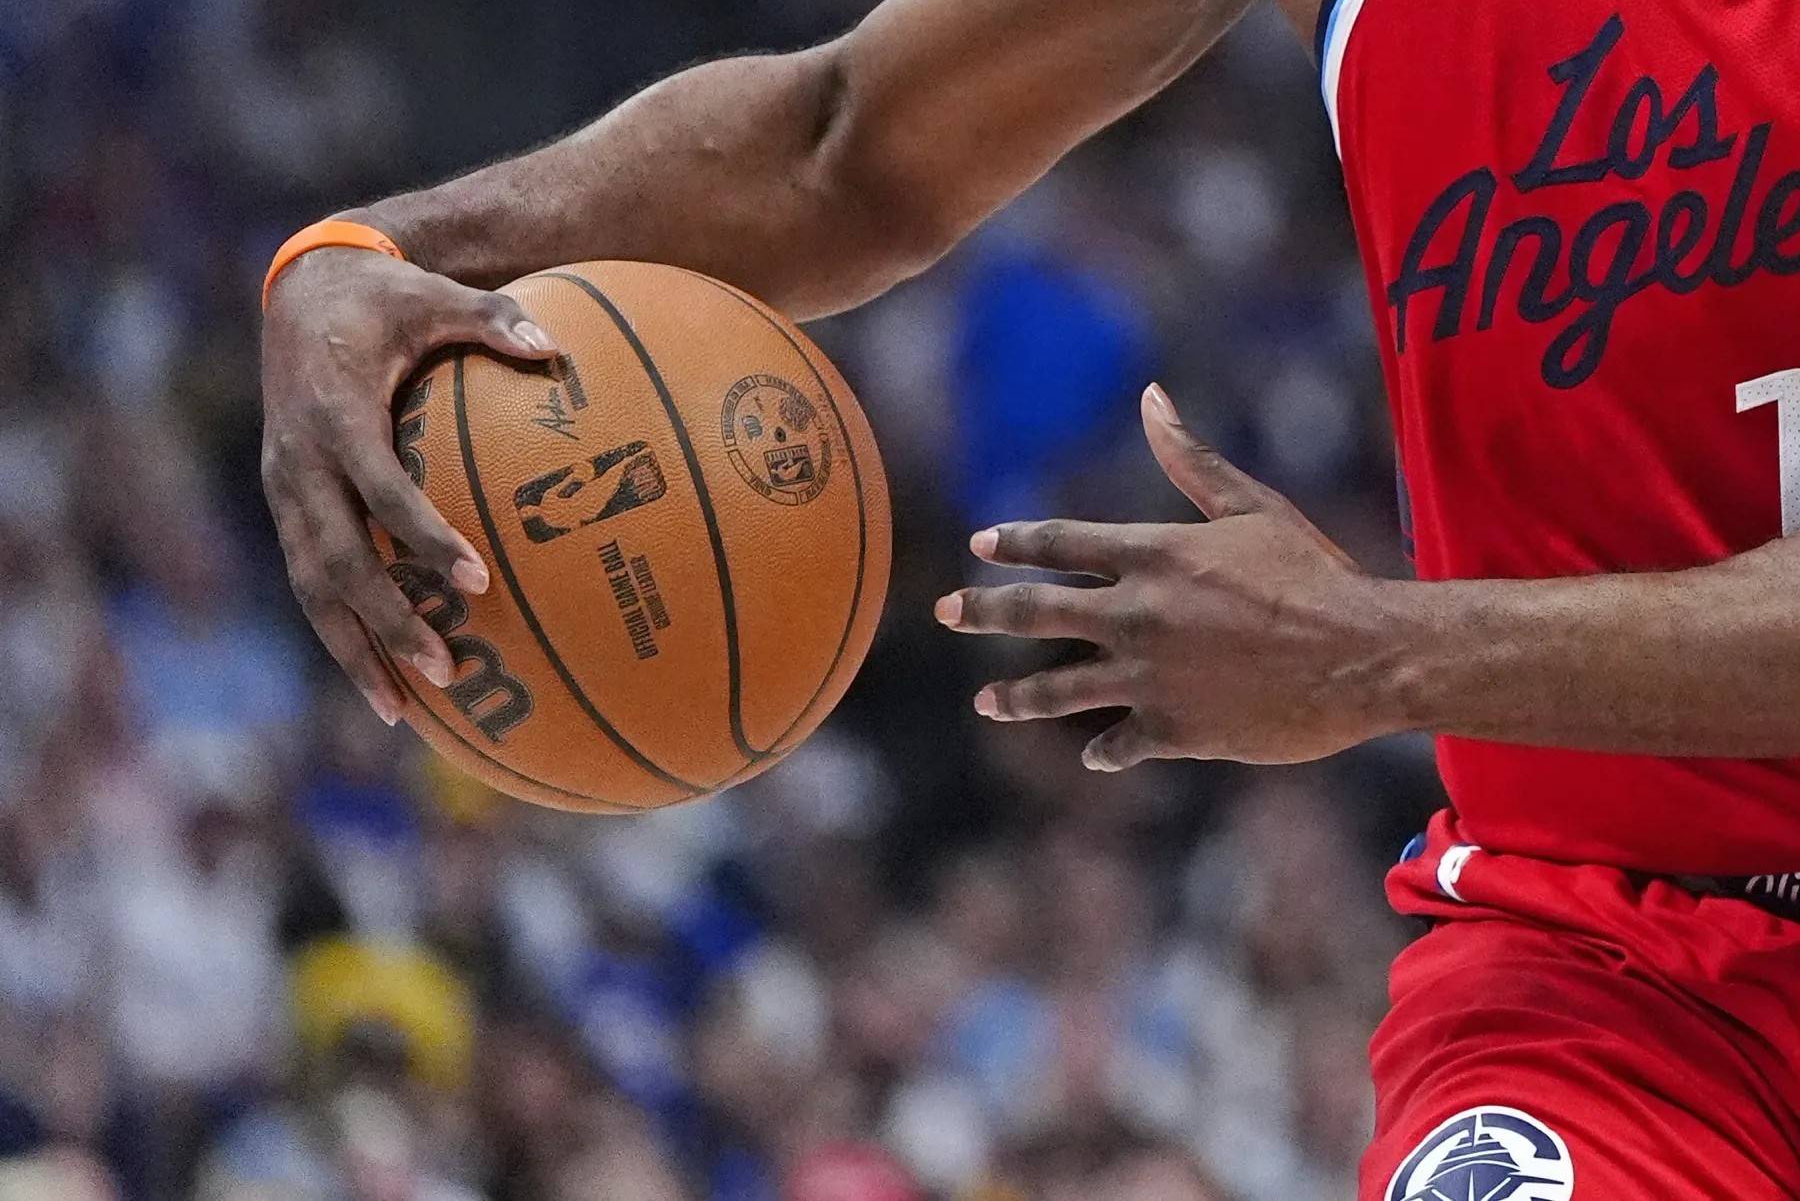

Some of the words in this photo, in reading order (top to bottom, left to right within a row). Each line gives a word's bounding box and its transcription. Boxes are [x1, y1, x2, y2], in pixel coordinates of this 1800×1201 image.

[1510, 13, 1738, 194] Los
[596, 538, 626, 574] BALL
[630, 553, 657, 595] LEATHER
[608, 570, 640, 610] GAME
[622, 606, 659, 660] OFFICIAL
